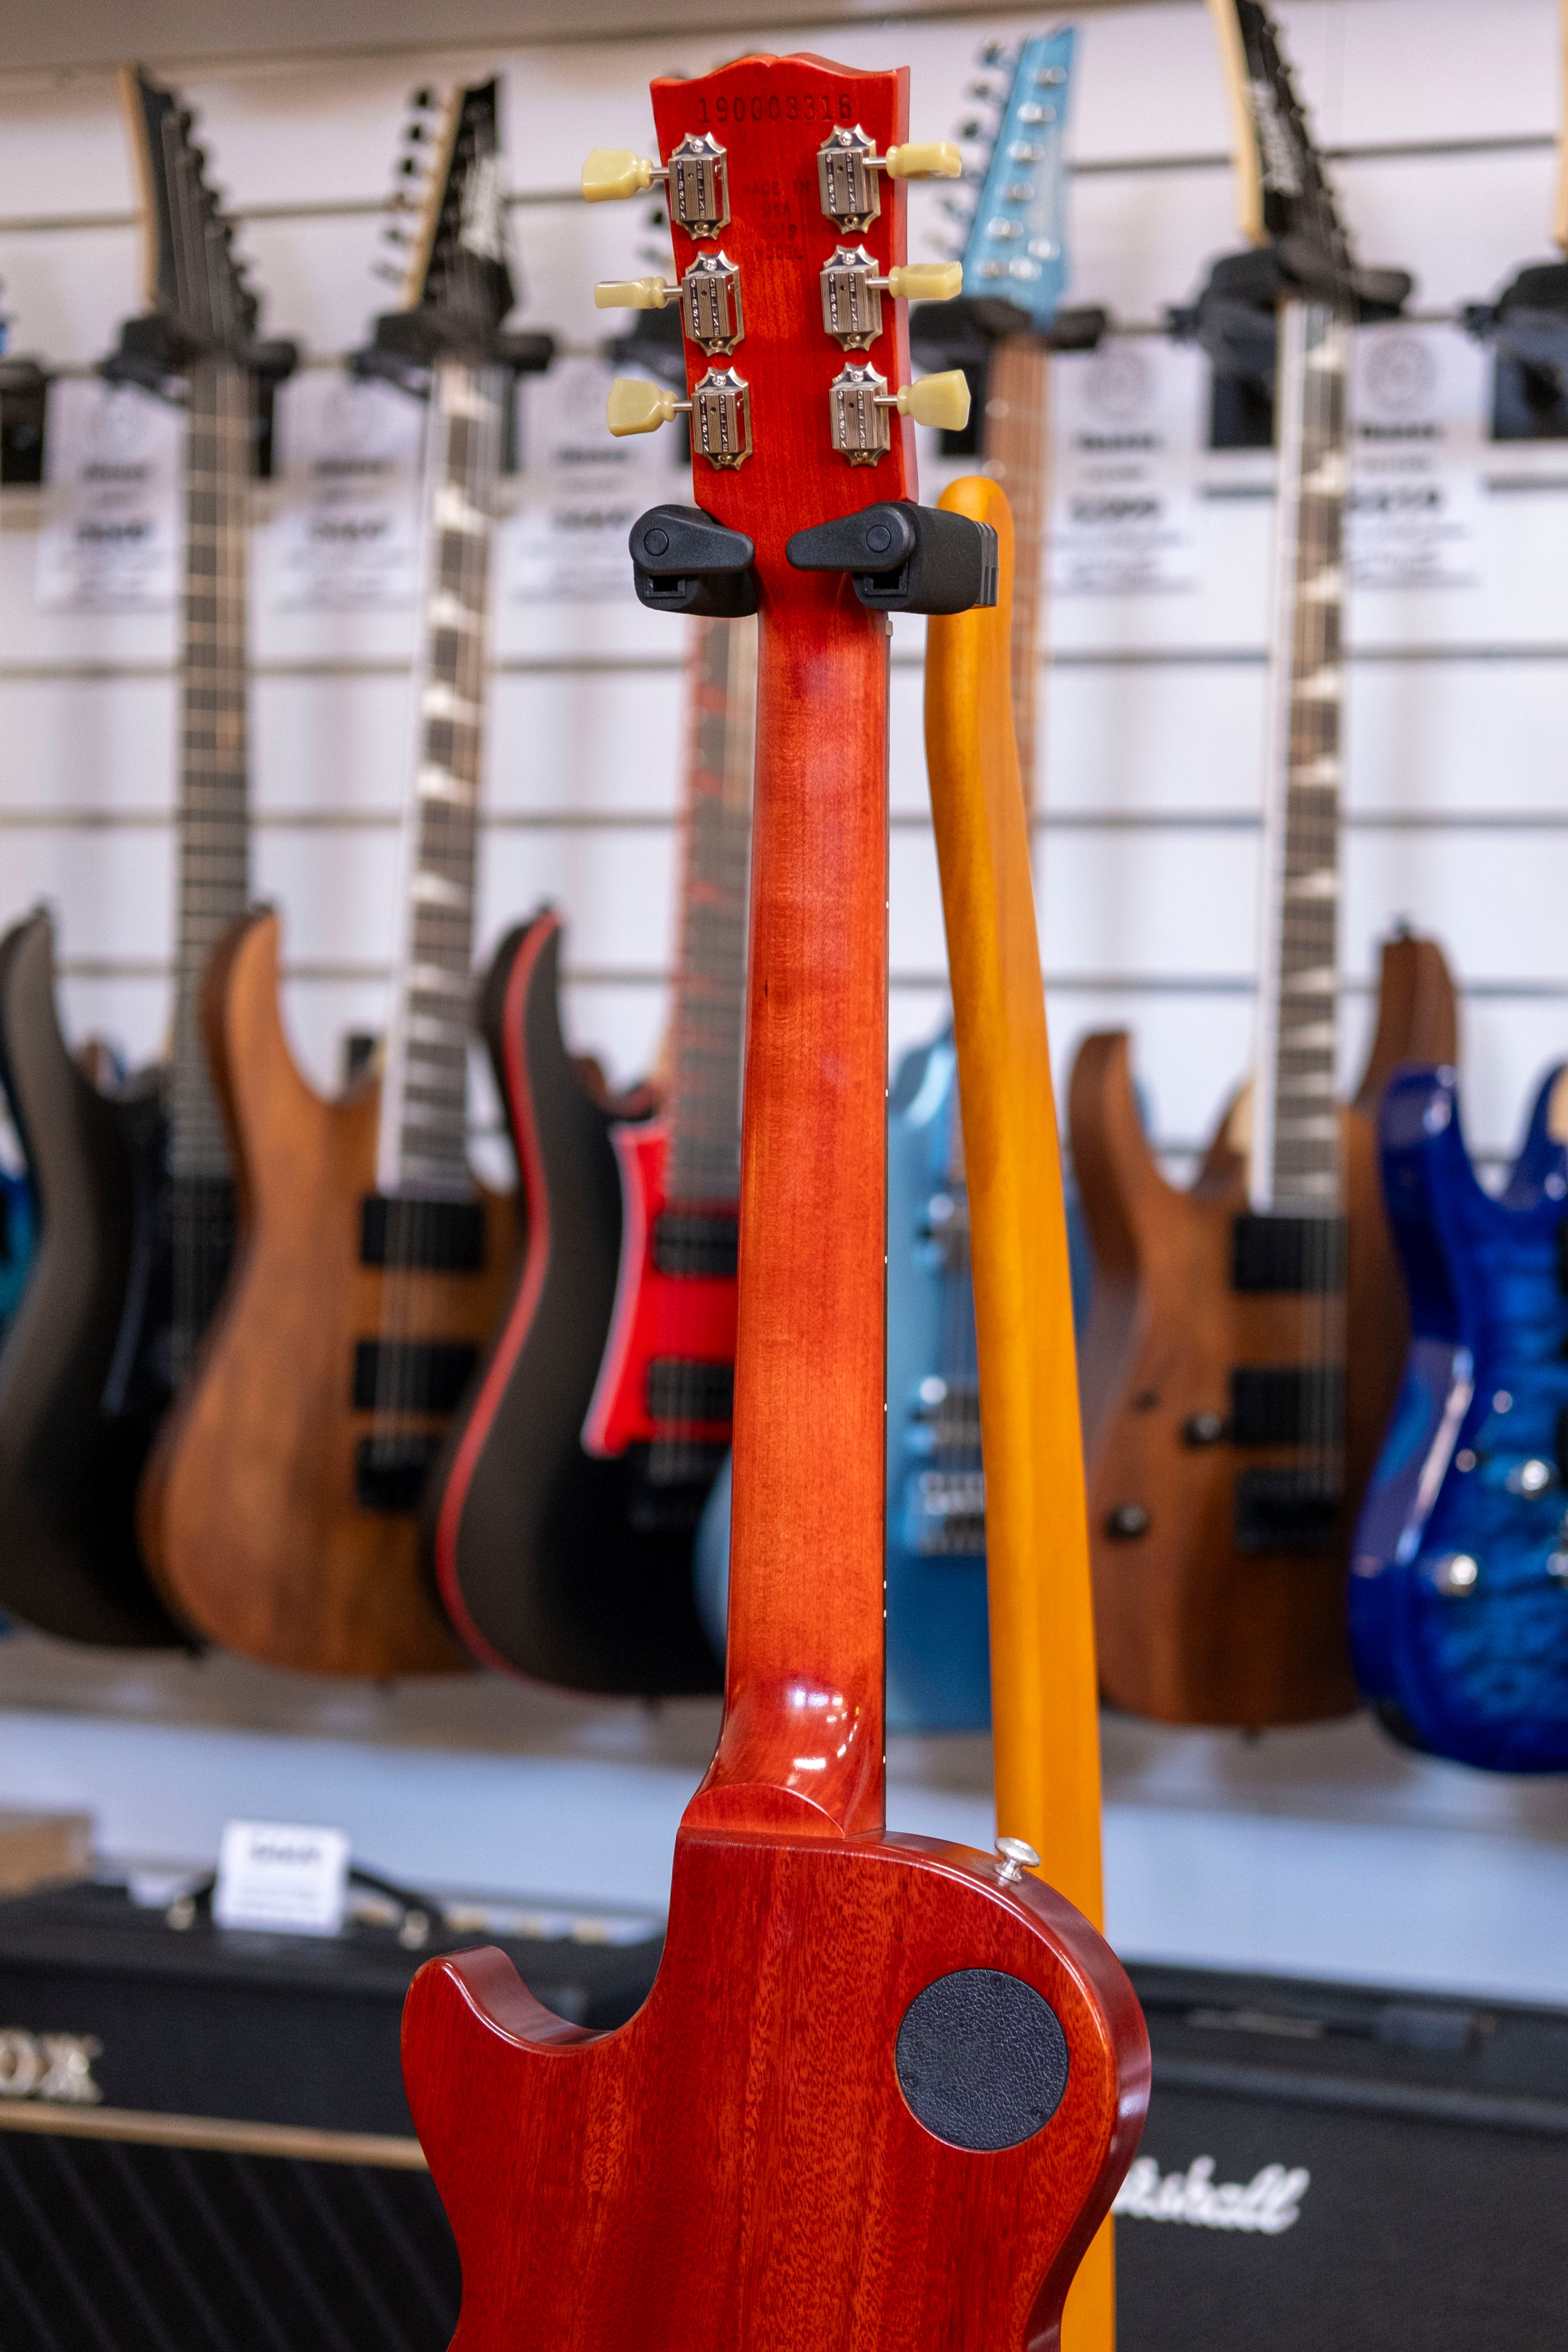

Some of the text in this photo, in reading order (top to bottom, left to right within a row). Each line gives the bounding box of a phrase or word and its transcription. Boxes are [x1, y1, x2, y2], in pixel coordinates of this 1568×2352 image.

[699, 94, 852, 123] 190003316
[677, 161, 686, 219] GIBSON
[763, 201, 791, 217] USA
[793, 180, 810, 194] IN
[826, 154, 836, 213] GIBSON
[691, 279, 700, 337] GIBSON
[710, 278, 719, 336] DELUXE
[830, 273, 838, 332] GIBSON
[701, 395, 709, 452] GIBSON
[720, 395, 728, 452] DELUXE
[0, 2026, 104, 2103] OX
